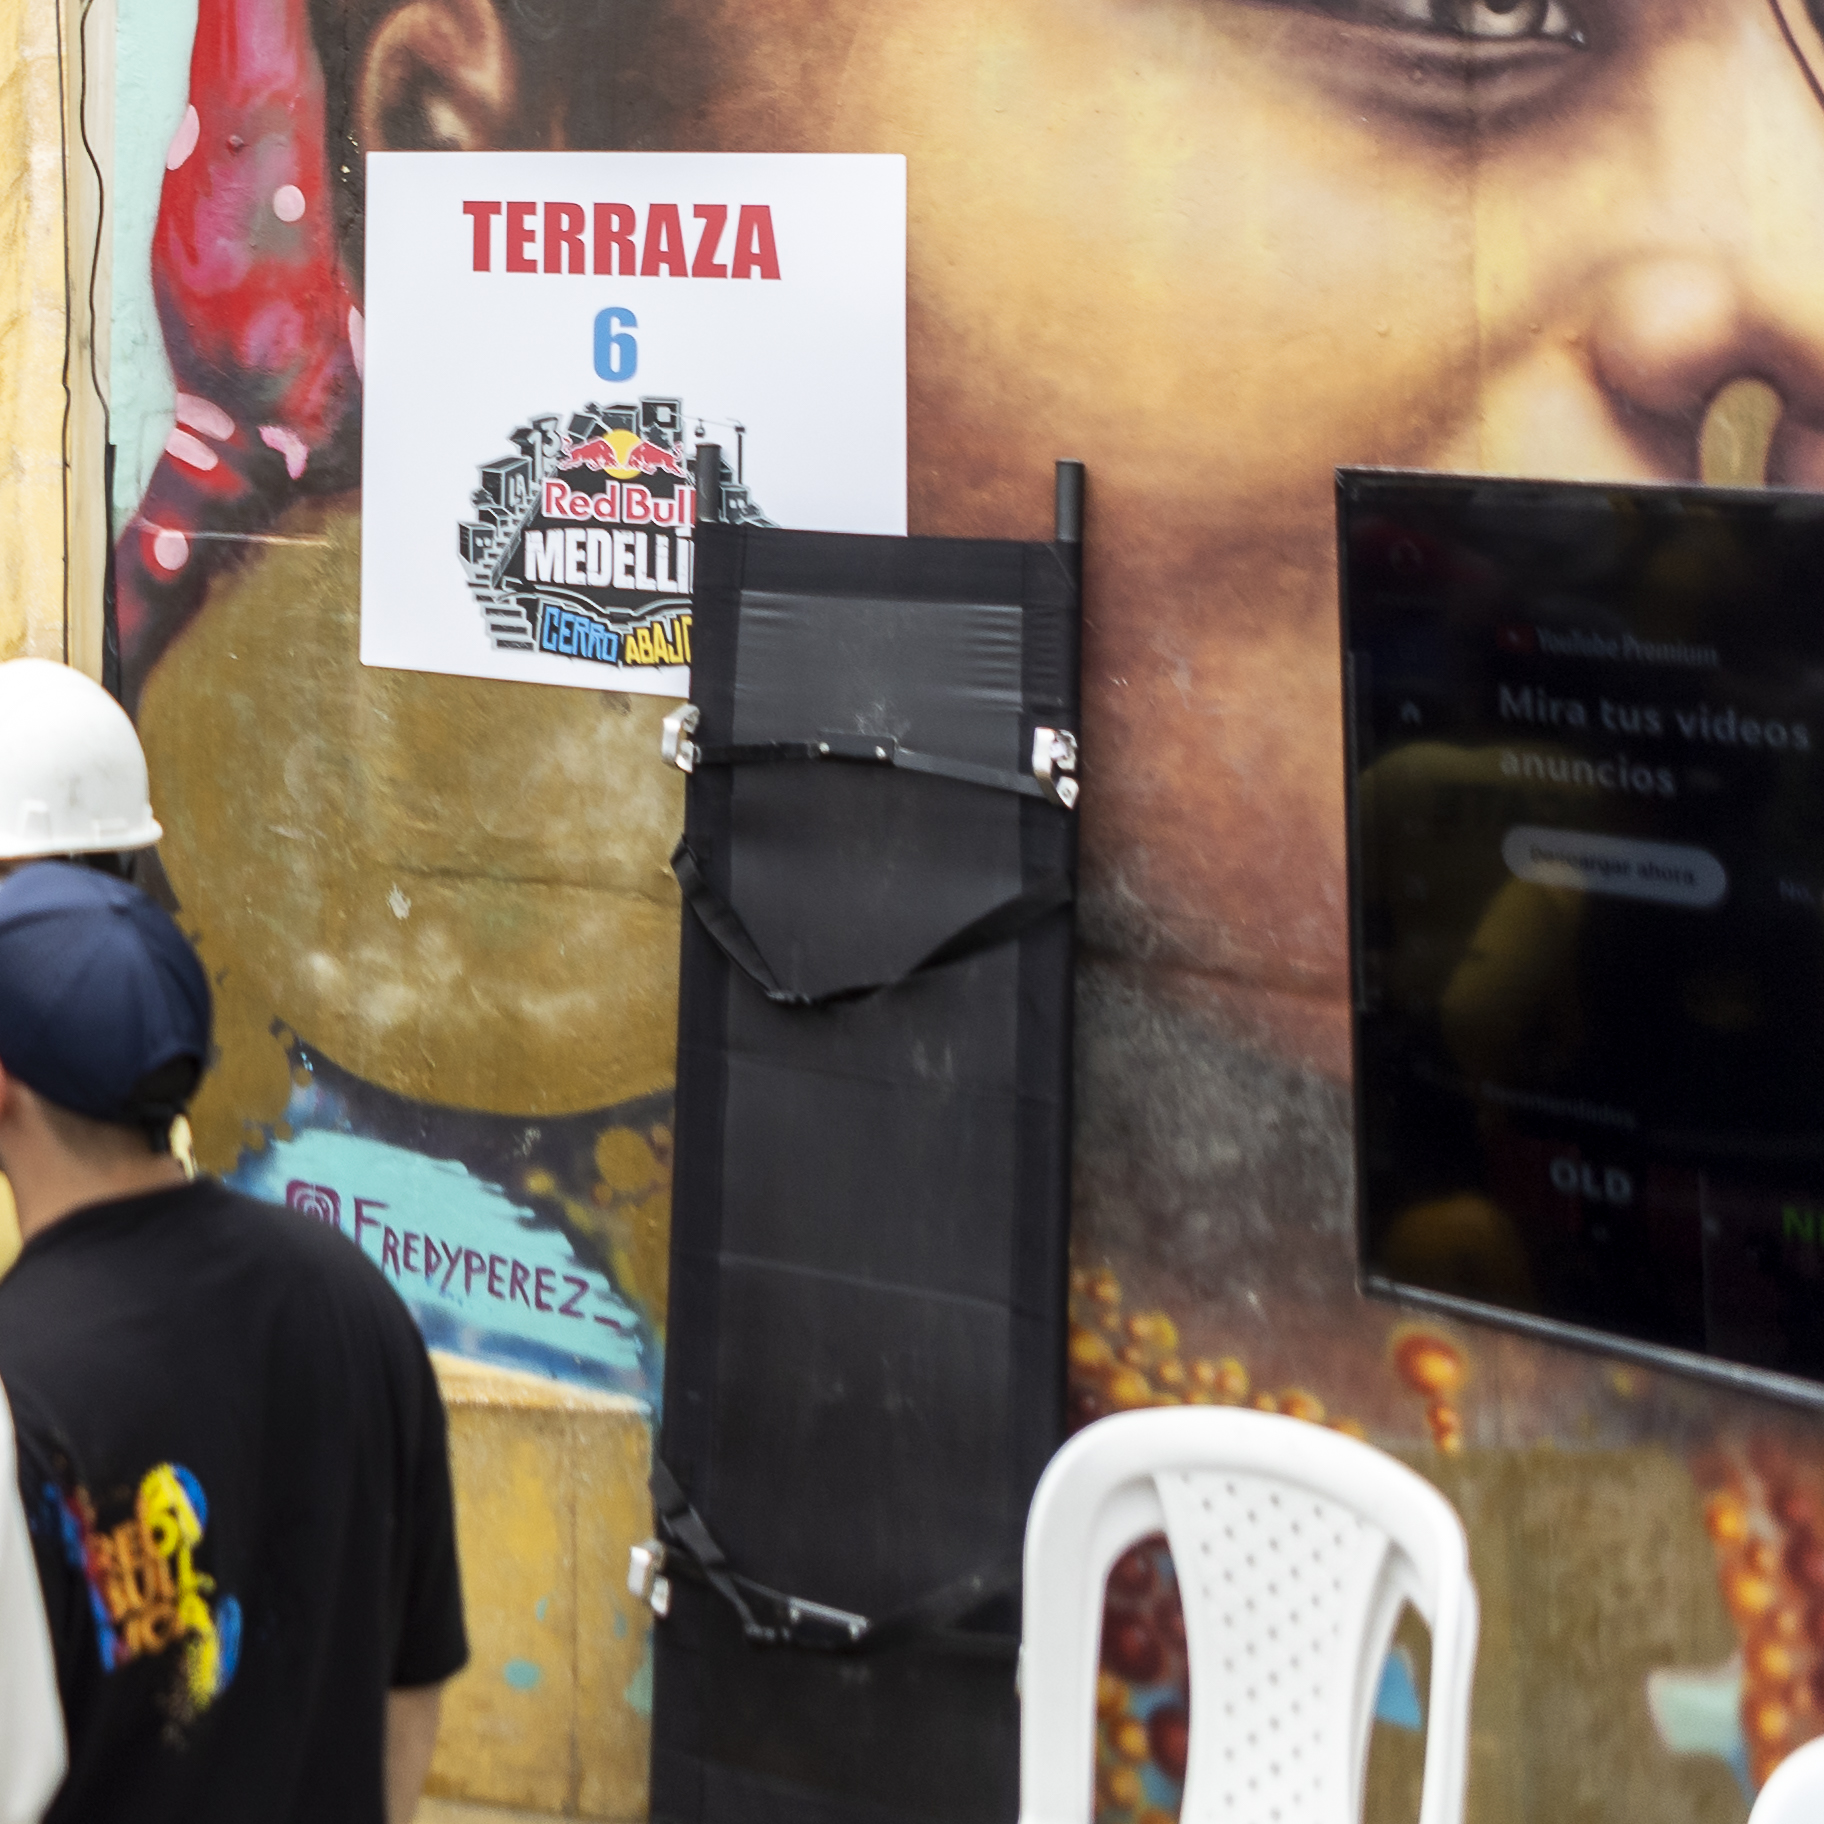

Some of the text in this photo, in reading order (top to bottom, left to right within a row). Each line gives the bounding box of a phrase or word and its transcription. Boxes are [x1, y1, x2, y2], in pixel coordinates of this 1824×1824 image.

[463, 200, 782, 281] TERRAZA
[592, 305, 640, 384] 6
[543, 480, 697, 529] Red Bull
[523, 526, 695, 595] MEDELLÍ
[542, 605, 619, 664] CERRO
[1499, 683, 1811, 751] Mira tus videos
[1499, 750, 1676, 795] anuncios
